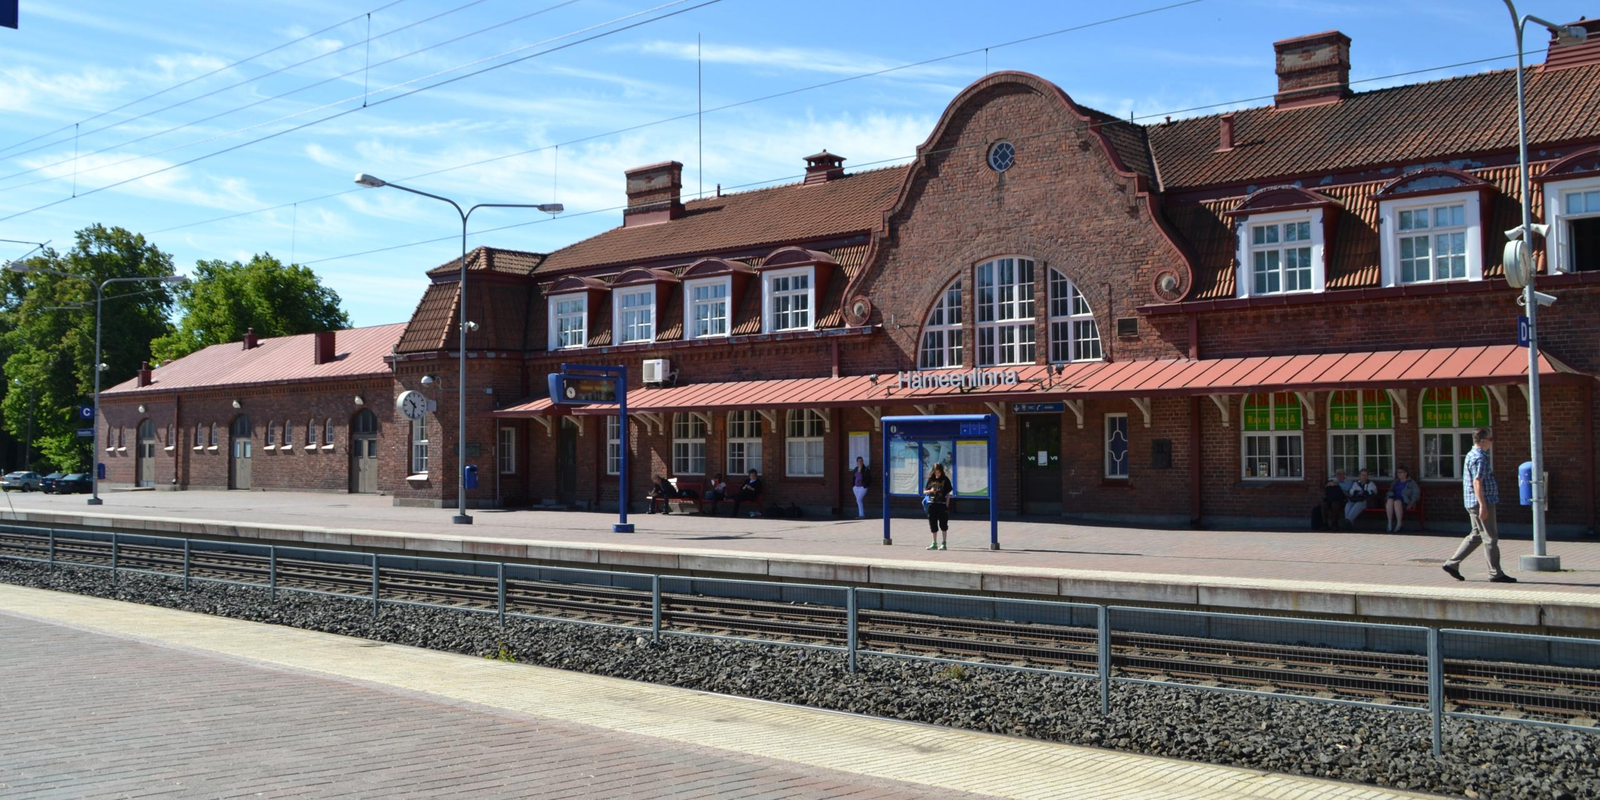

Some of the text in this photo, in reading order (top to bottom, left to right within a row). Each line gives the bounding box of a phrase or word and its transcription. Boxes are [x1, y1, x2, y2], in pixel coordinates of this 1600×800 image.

[1520, 321, 1528, 341] D
[898, 367, 1018, 390] Hämeenlinna
[1335, 389, 1387, 403] ASEMA
[1427, 386, 1485, 401] ASEMA
[82, 407, 91, 417] C
